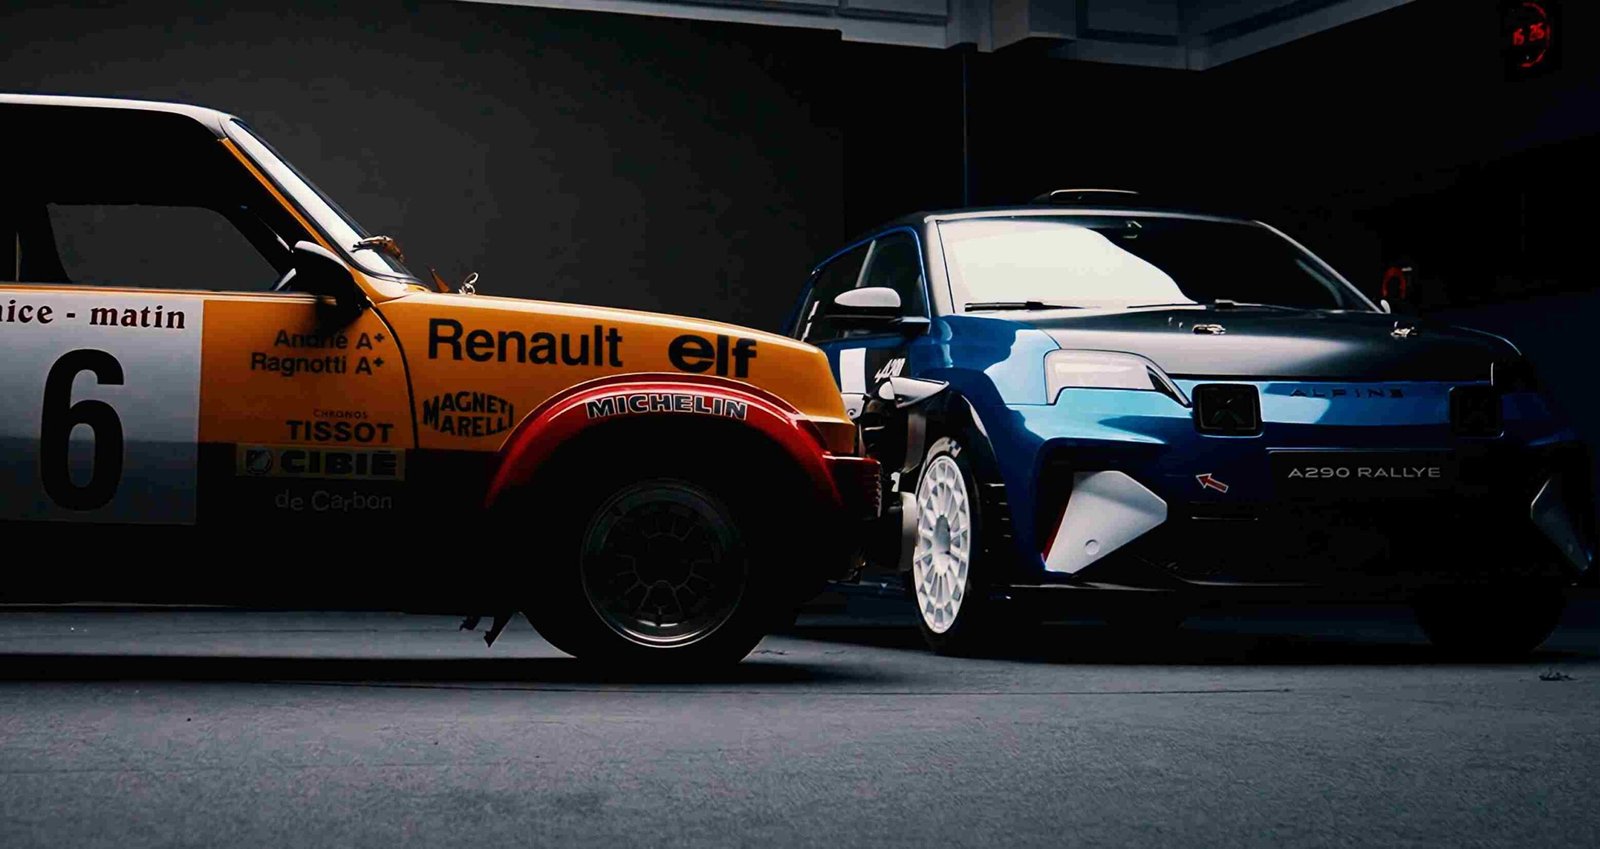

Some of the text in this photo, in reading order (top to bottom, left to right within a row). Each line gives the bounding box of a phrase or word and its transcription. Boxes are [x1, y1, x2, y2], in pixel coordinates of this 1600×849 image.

[0, 300, 53, 324] ice
[90, 305, 185, 329] matin
[428, 317, 623, 367] Renault
[251, 352, 347, 377] Ragnotti
[668, 335, 757, 378] elf
[423, 391, 514, 419] MAGNETI
[585, 393, 748, 421] MICHELIN
[1290, 388, 1404, 399] ALPINE
[313, 408, 369, 420] CHRONOS
[423, 409, 514, 437] MARELLI
[41, 348, 125, 511] 6
[286, 420, 394, 443] TISSOT
[1287, 466, 1441, 479] A290 RALLYE
[274, 488, 393, 513] de Carbon
